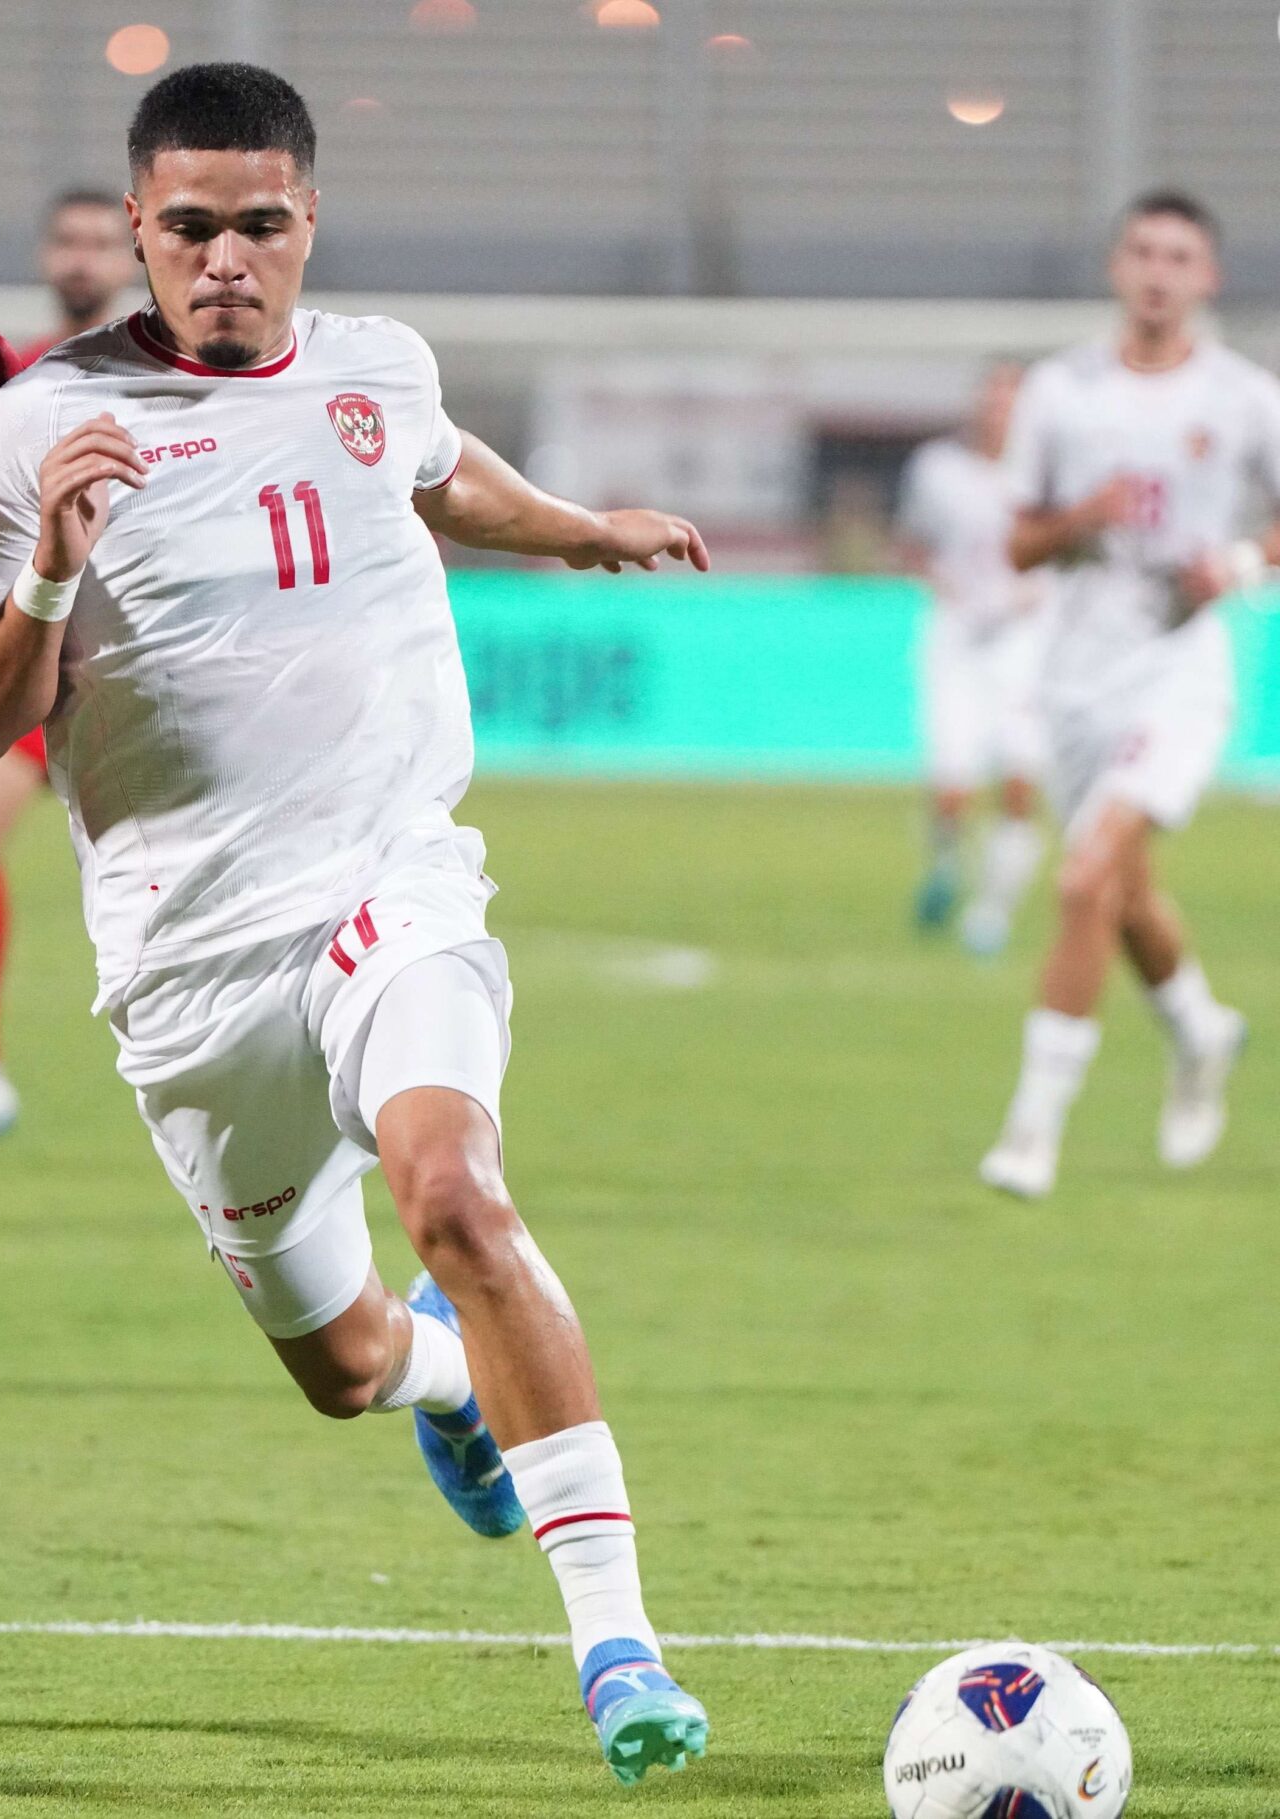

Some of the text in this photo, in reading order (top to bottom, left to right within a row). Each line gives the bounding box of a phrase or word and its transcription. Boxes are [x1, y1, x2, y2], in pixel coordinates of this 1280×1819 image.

[140, 438, 217, 463] erspo
[258, 480, 330, 590] 11
[223, 1186, 296, 1220] erspo
[895, 1751, 965, 1783] molten
